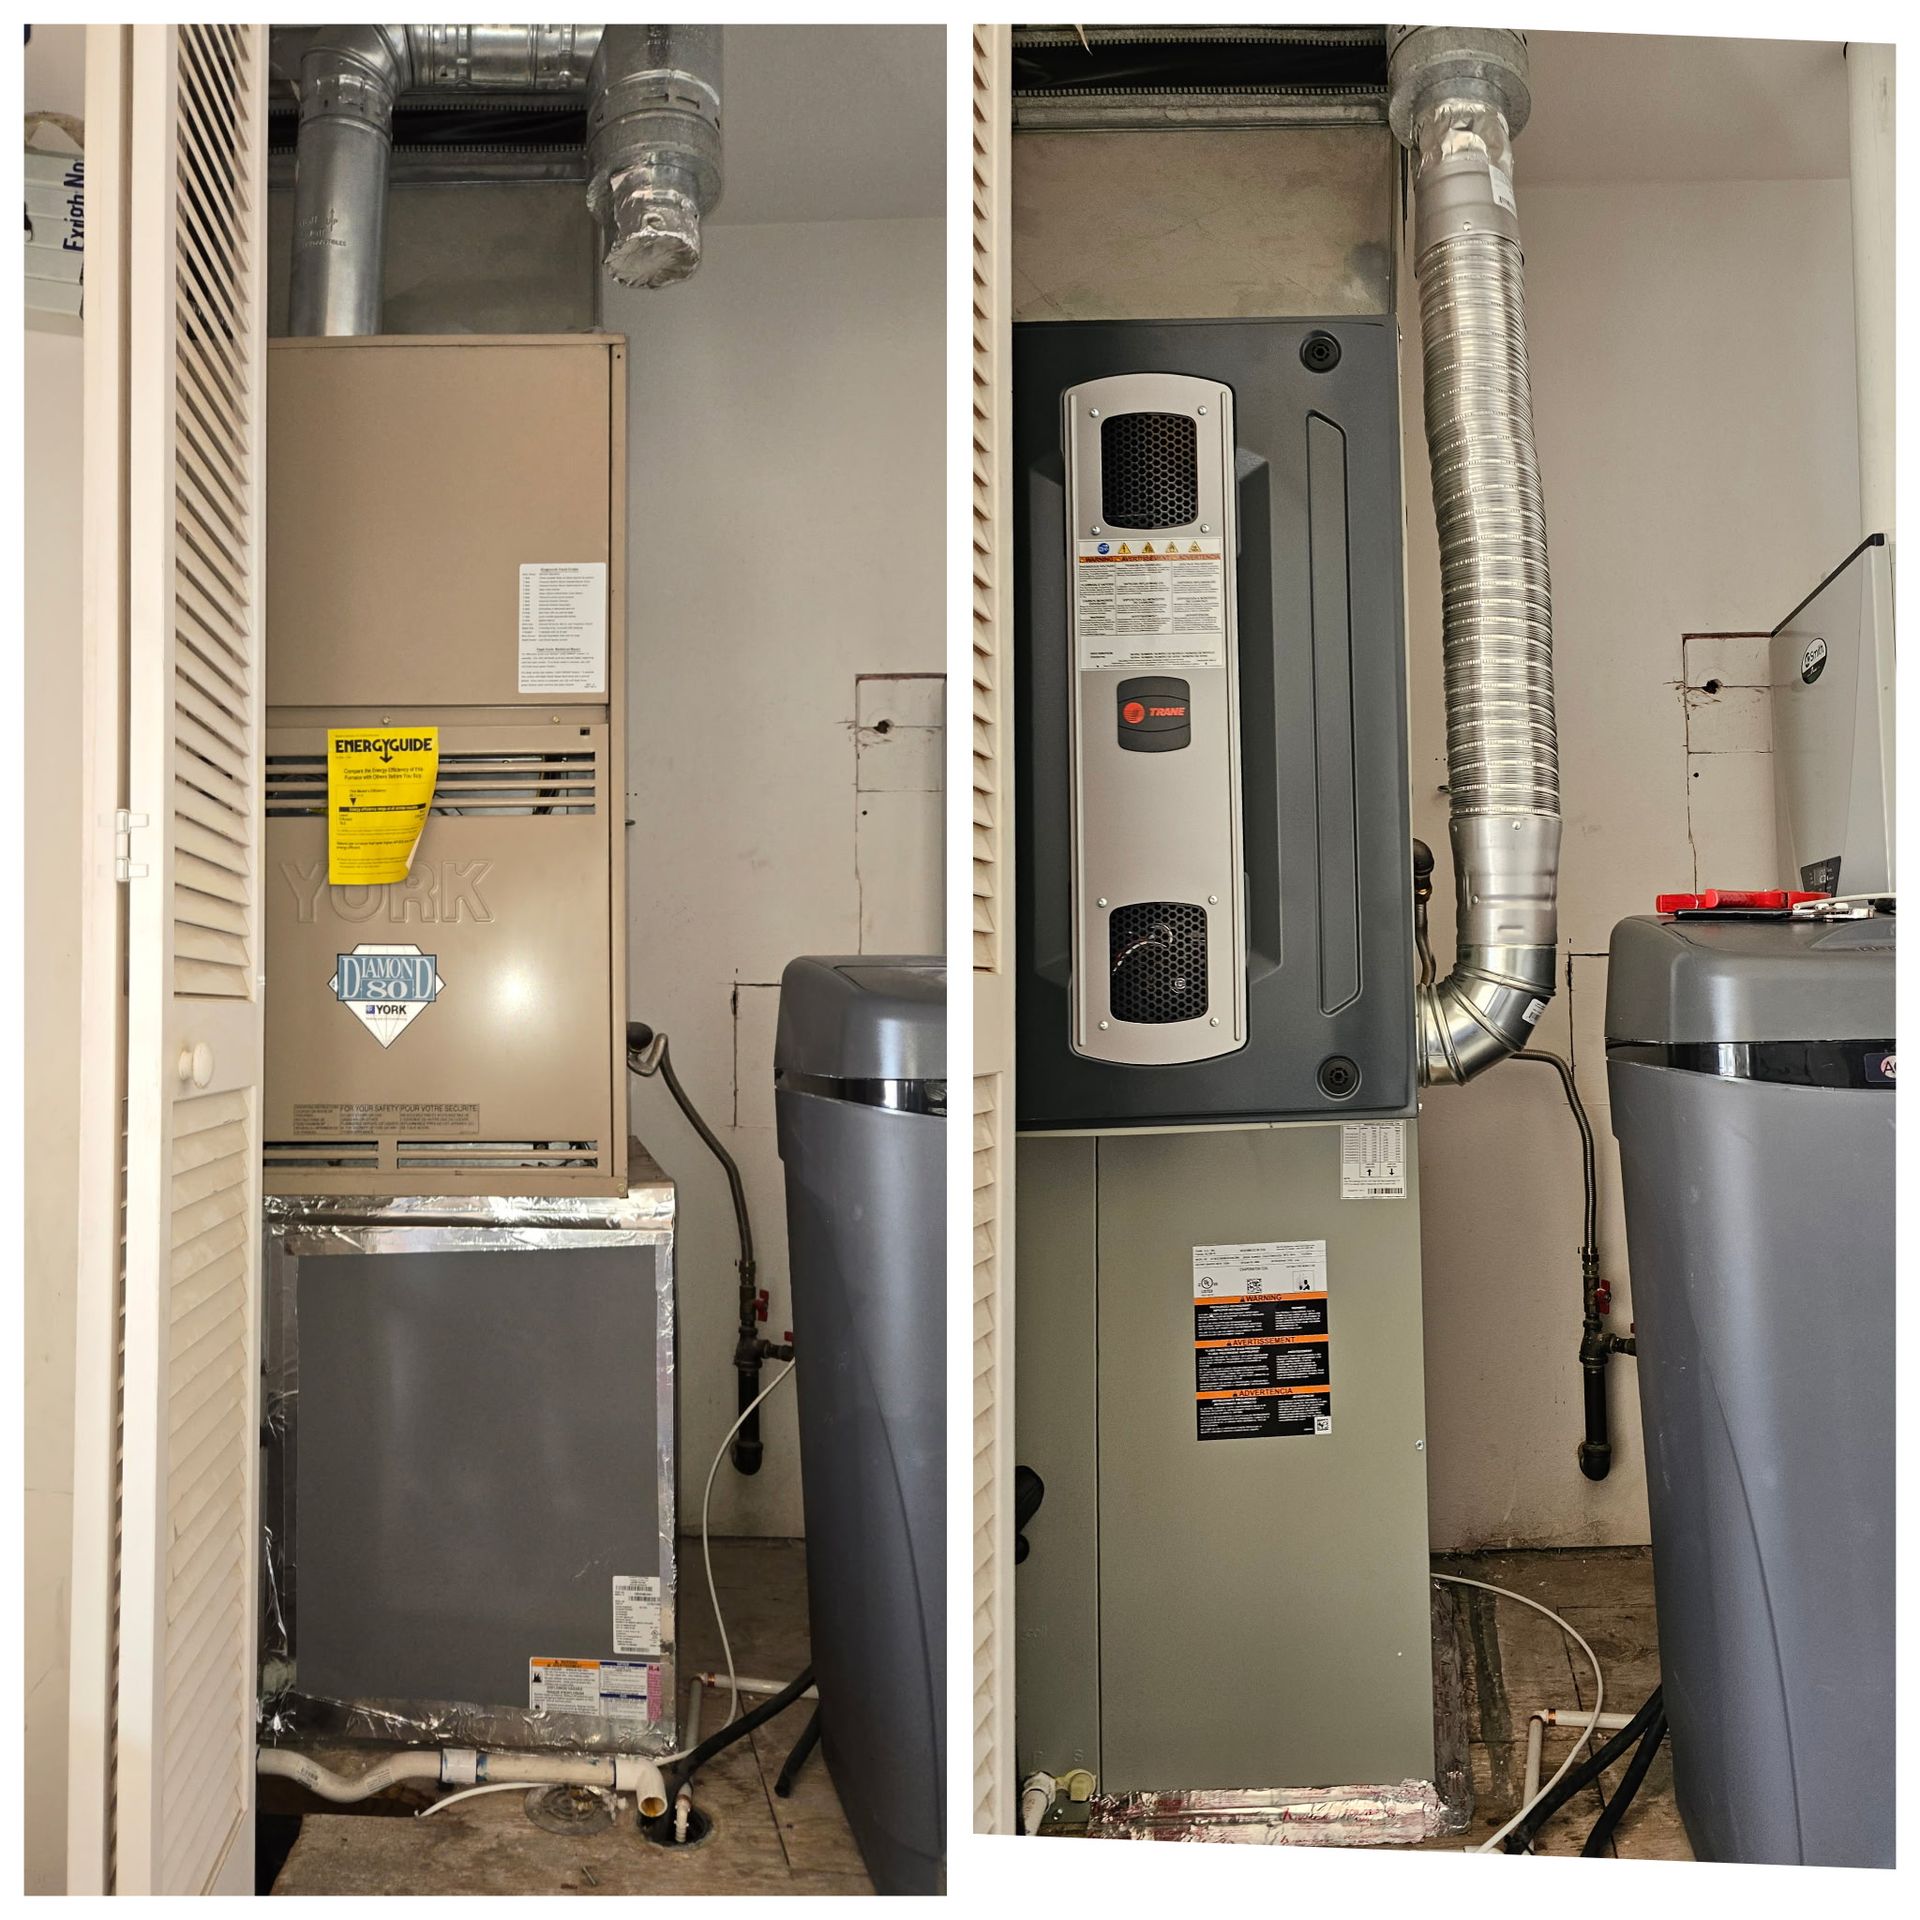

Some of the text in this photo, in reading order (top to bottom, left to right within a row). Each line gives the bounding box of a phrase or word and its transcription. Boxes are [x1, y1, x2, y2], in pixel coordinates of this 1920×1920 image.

[1149, 707, 1186, 717] TRANE
[335, 738, 433, 757] ENERGYGUIDE
[279, 860, 496, 923] YORK
[341, 957, 434, 999] DIAMOND
[366, 979, 408, 999] 80
[376, 1004, 408, 1015] YORK
[1245, 1293, 1282, 1302] WARNING
[1232, 1336, 1296, 1347] AVERTISSEMENT
[1239, 1387, 1293, 1397] ADVERTENCIA
